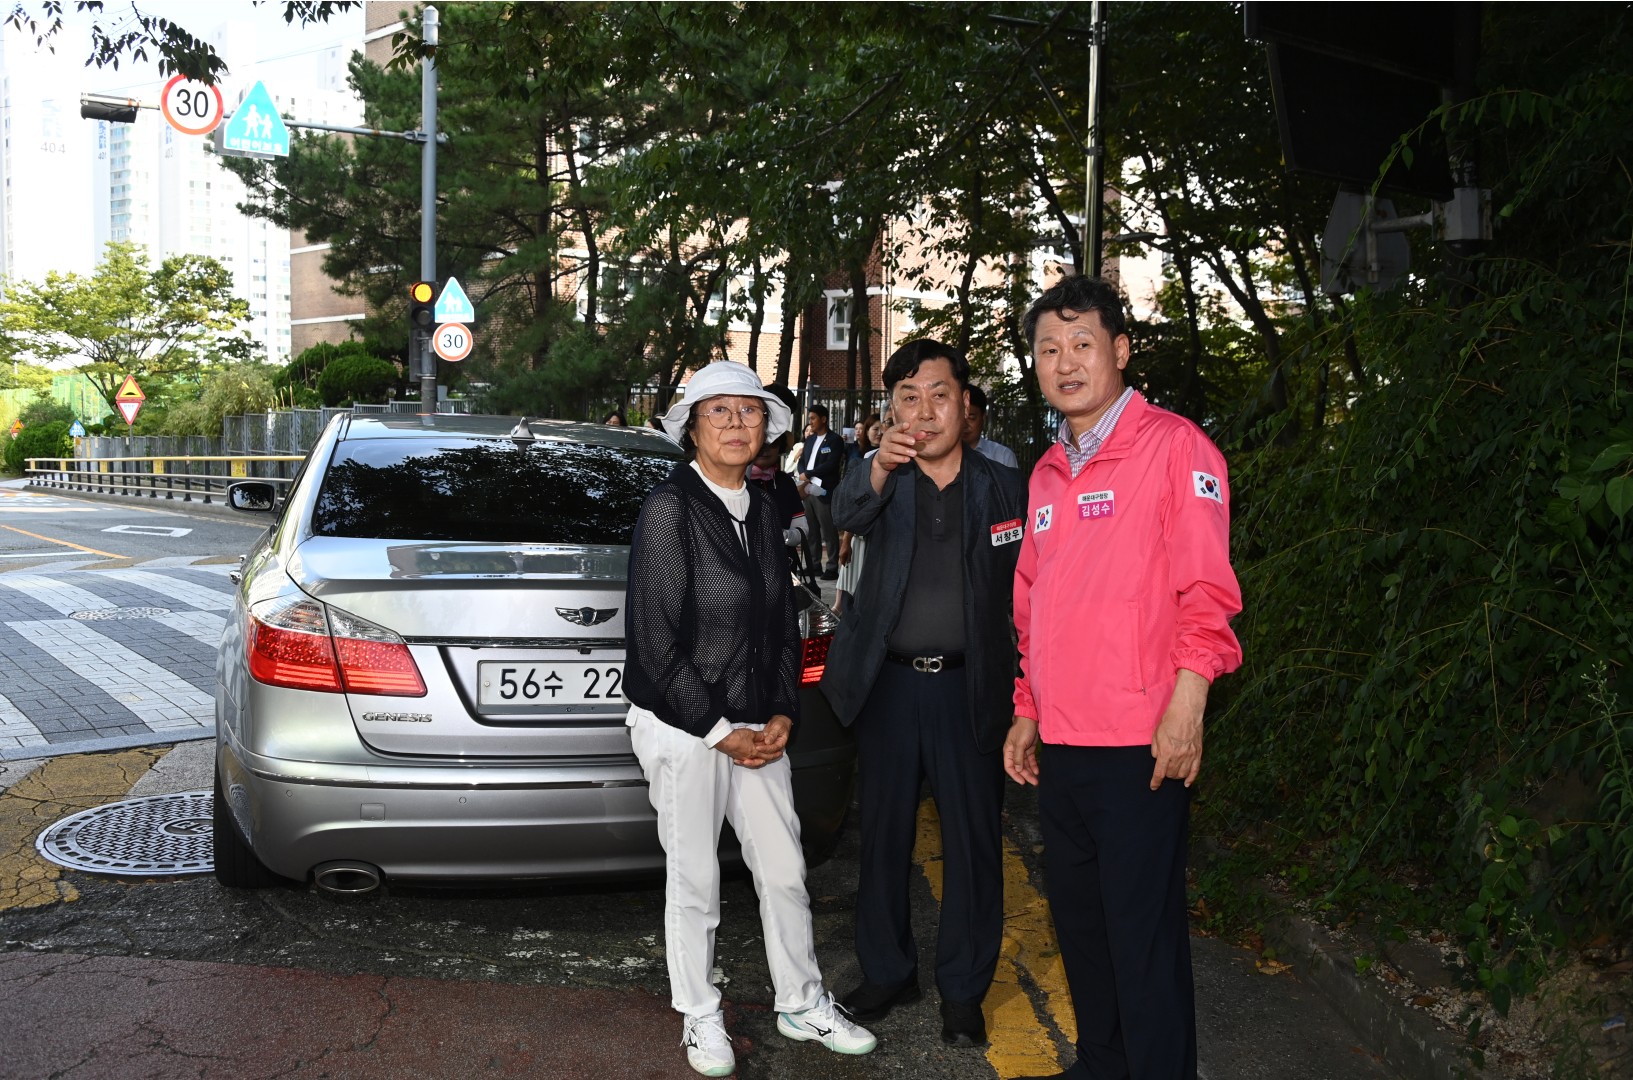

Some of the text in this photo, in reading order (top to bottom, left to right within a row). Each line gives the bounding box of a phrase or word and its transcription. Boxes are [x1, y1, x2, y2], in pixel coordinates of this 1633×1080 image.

[176, 88, 209, 118] 30
[40, 141, 66, 154] 404
[443, 333, 464, 349] 30
[1082, 493, 1109, 501] 해운대구청장
[1082, 503, 1110, 517] 김성수
[996, 529, 1020, 543] 서창우
[500, 667, 622, 699] 56수 22
[362, 711, 433, 723] GENESIS
